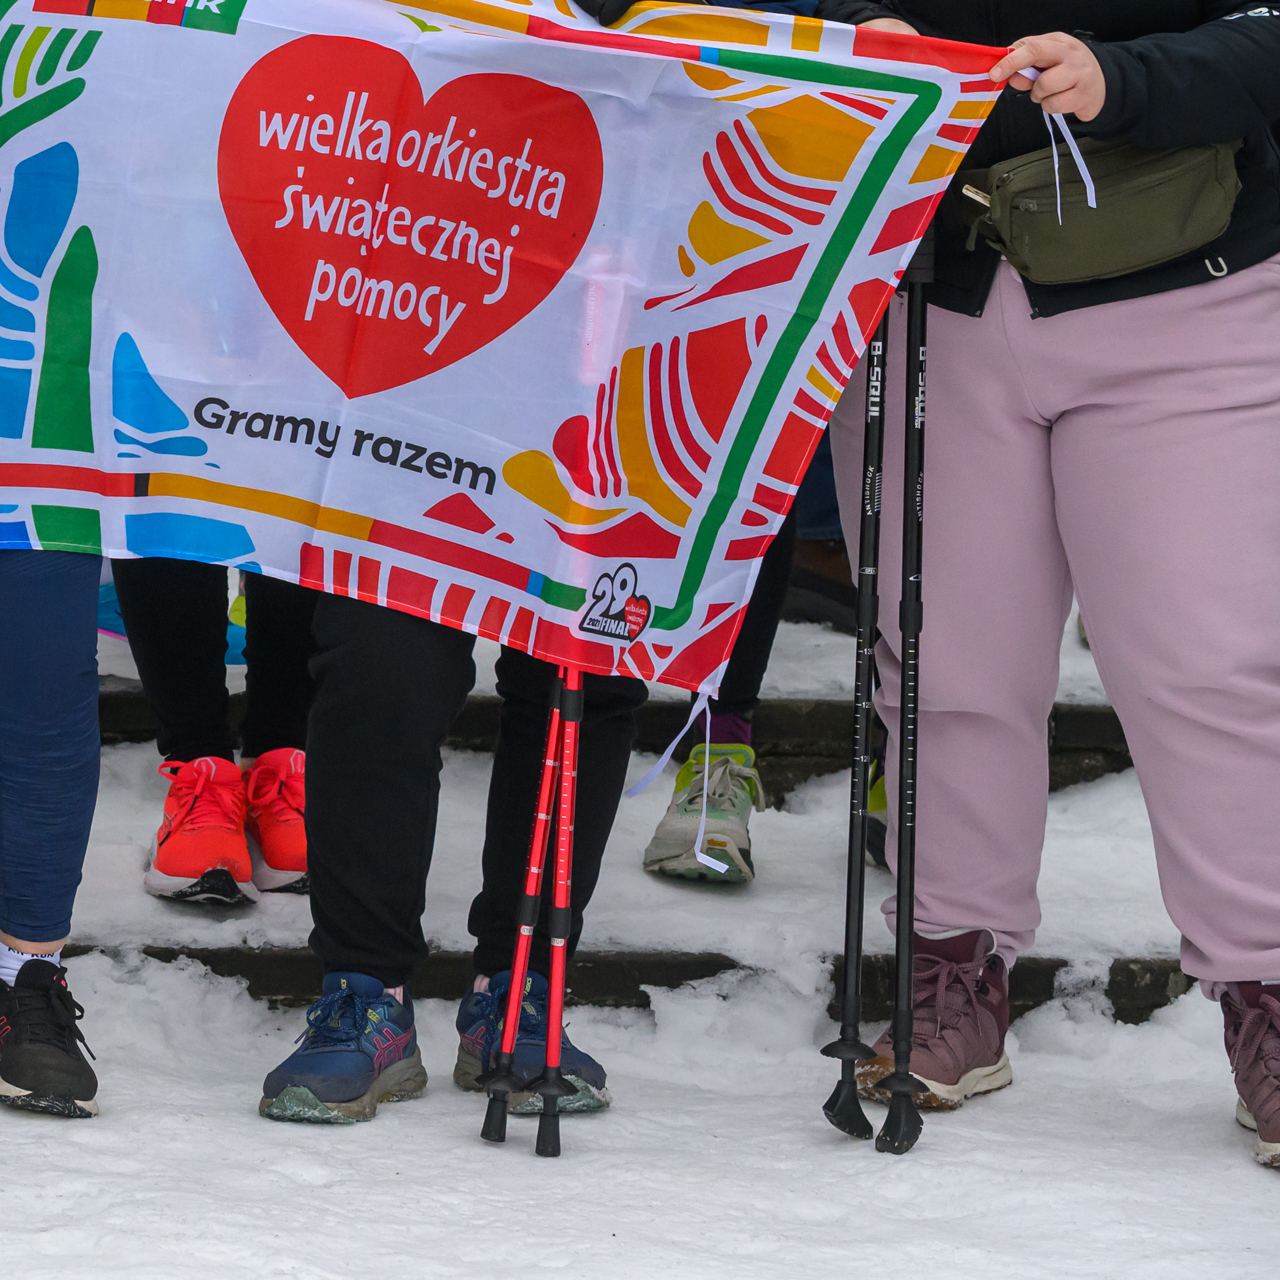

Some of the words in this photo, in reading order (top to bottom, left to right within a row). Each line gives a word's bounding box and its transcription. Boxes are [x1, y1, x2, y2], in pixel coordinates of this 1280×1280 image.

[258, 90, 392, 164] wielka
[396, 115, 567, 220] orkiestra
[274, 166, 521, 305] świątecznej
[303, 258, 467, 356] pomocy
[193, 396, 342, 459] Gramy
[351, 428, 498, 496] razem
[864, 464, 875, 516] ANTISHOCK
[580, 562, 639, 634] 29
[586, 617, 601, 629] 2021
